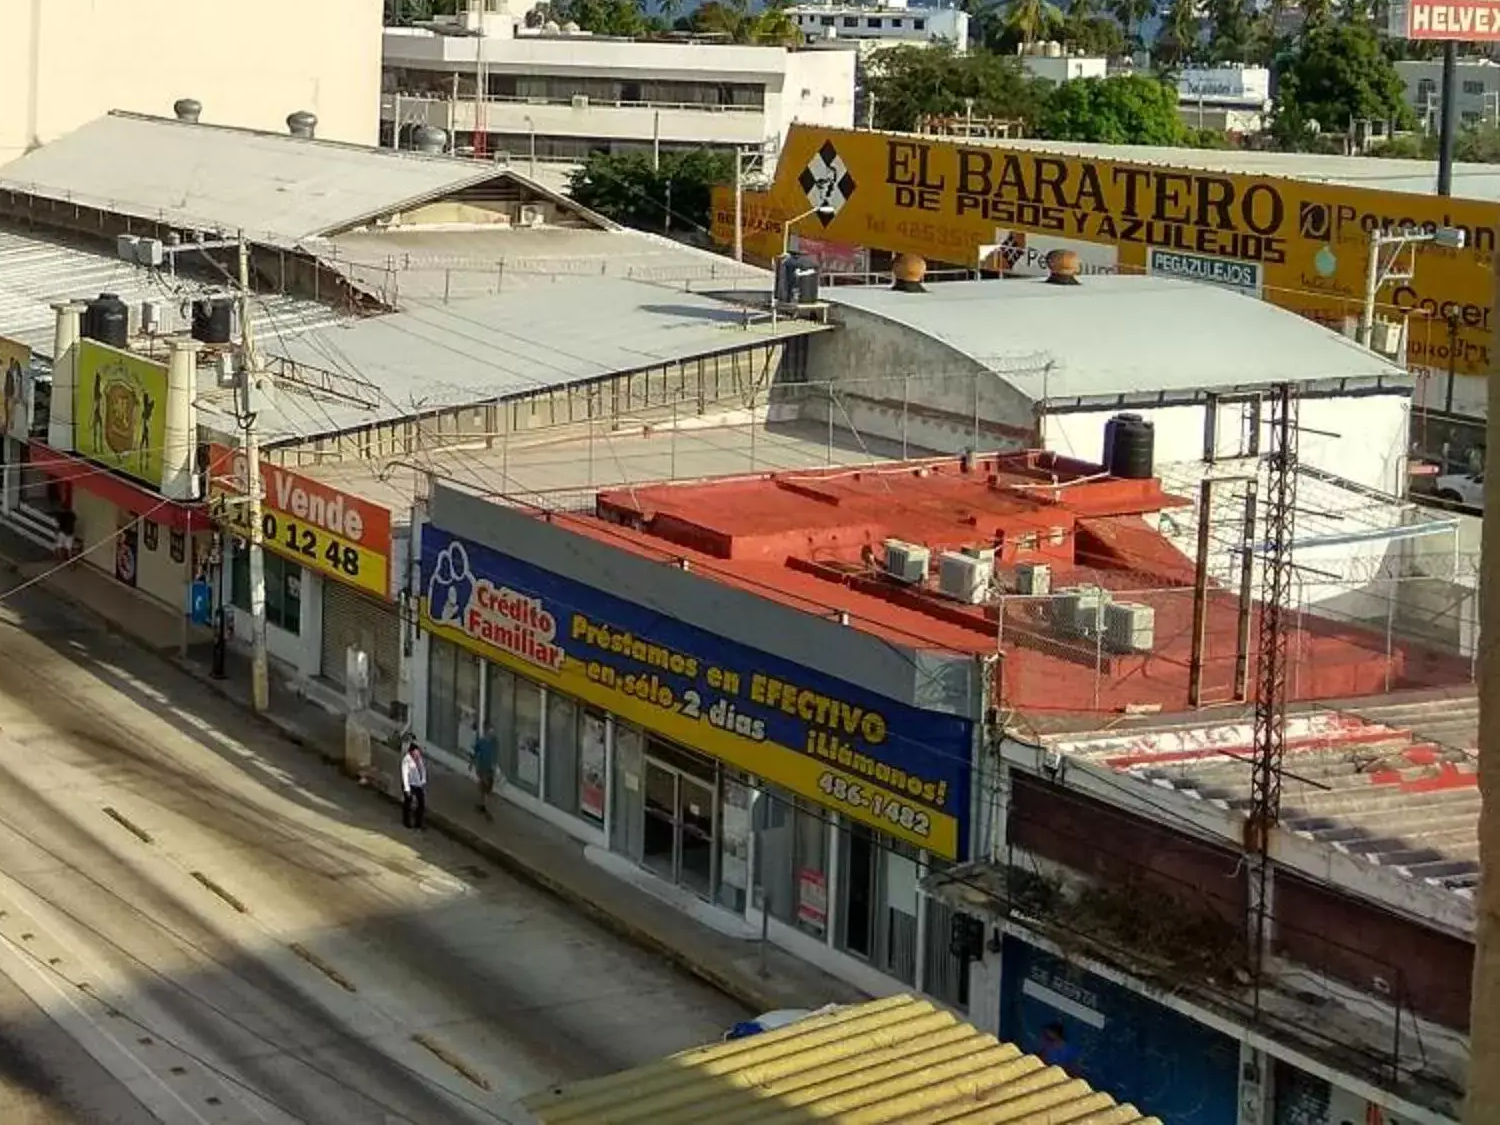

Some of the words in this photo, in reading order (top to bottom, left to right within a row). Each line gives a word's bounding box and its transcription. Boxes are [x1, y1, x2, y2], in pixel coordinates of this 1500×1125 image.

[885, 141, 944, 190] EL
[956, 149, 1285, 236] BARATERO
[895, 187, 941, 211] DE
[956, 195, 1065, 230] PISOS
[1073, 211, 1089, 234] Y
[1096, 215, 1287, 263] AZULEJOS
[1154, 253, 1252, 285] PEGAZULEJOS
[273, 471, 364, 541] Vende
[286, 523, 317, 560] 12
[325, 541, 360, 576] 48
[468, 609, 563, 668] Familiar
[476, 584, 551, 634] Crédito
[571, 612, 699, 677] Préstamos
[706, 665, 740, 695] en
[750, 672, 887, 744] EFECTIVO
[586, 659, 616, 687] en
[623, 675, 674, 709] sólo
[683, 689, 703, 719] 2
[708, 698, 767, 741] días
[817, 772, 931, 836] 486-1482
